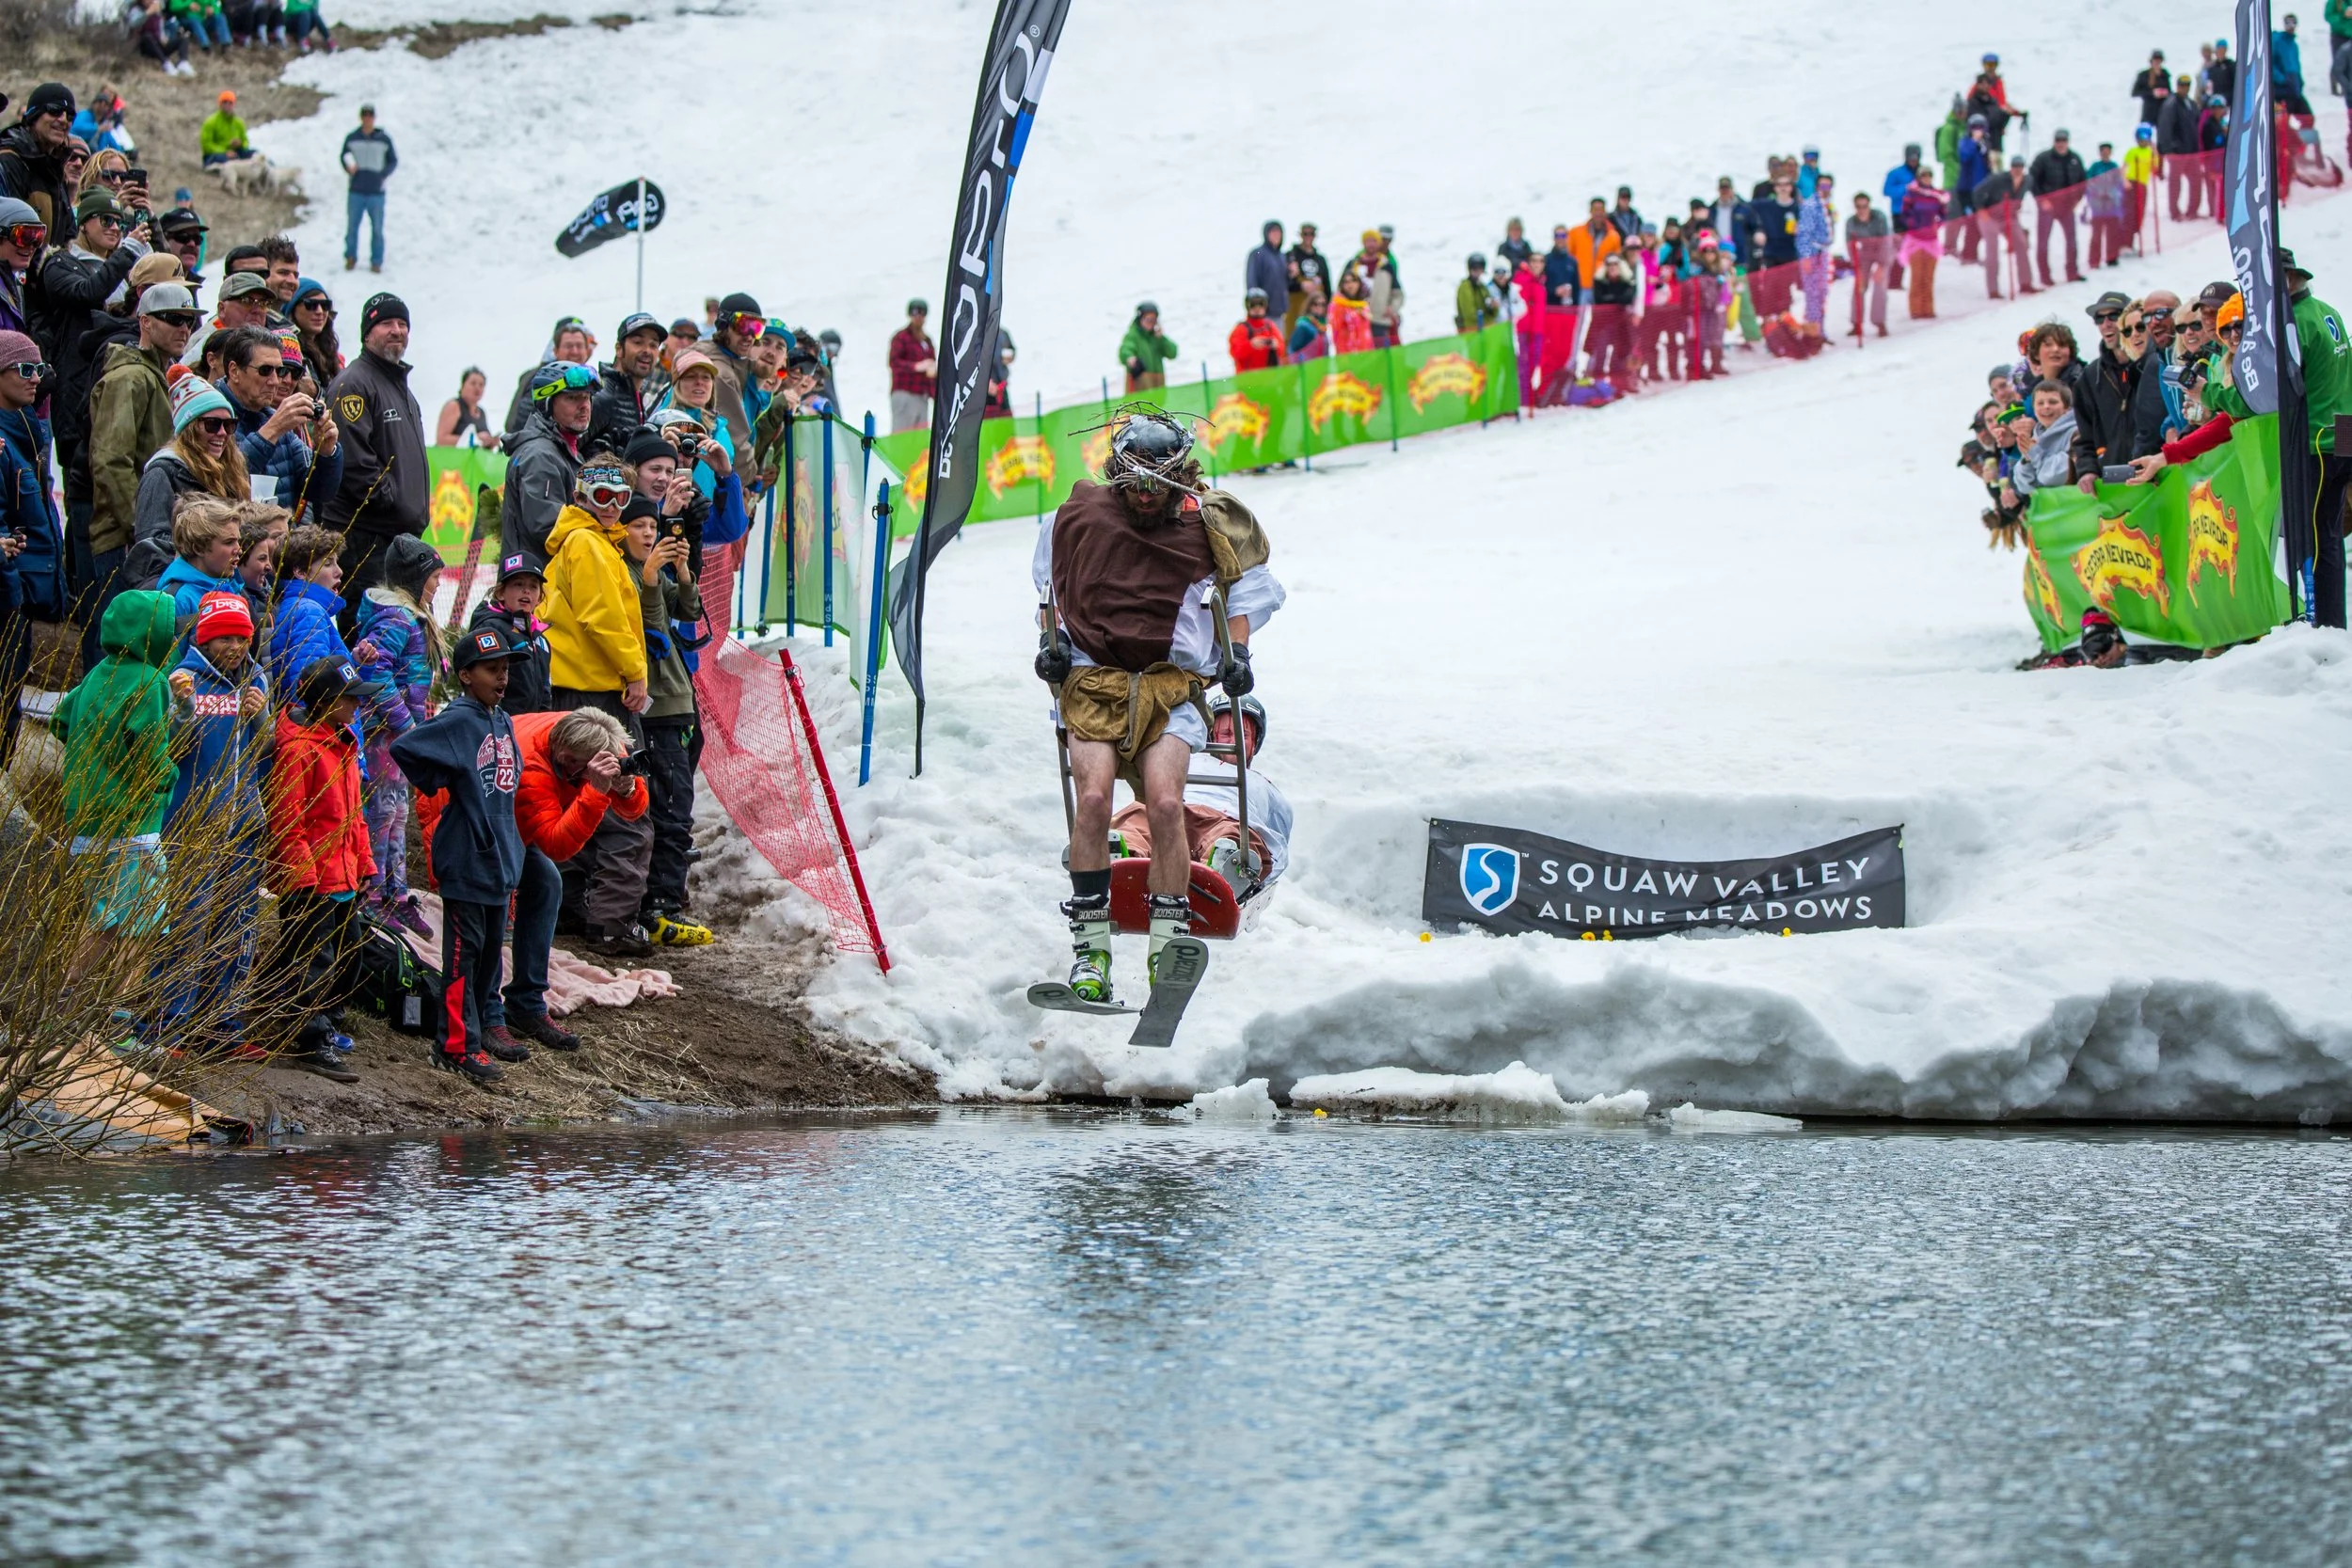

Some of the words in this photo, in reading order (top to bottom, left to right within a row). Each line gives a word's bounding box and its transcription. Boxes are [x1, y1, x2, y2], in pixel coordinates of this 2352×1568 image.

[2105, 543, 2153, 576] NEVADA
[500, 768, 514, 786] 22
[1538, 860, 1699, 897] SQUAW
[1713, 857, 1869, 899] VALLEY
[1078, 910, 1108, 920] BOOSTER
[1153, 908, 1184, 919] BOOSTER
[1537, 900, 1666, 926] ALPINE
[1686, 895, 1872, 923] MEADOWS
